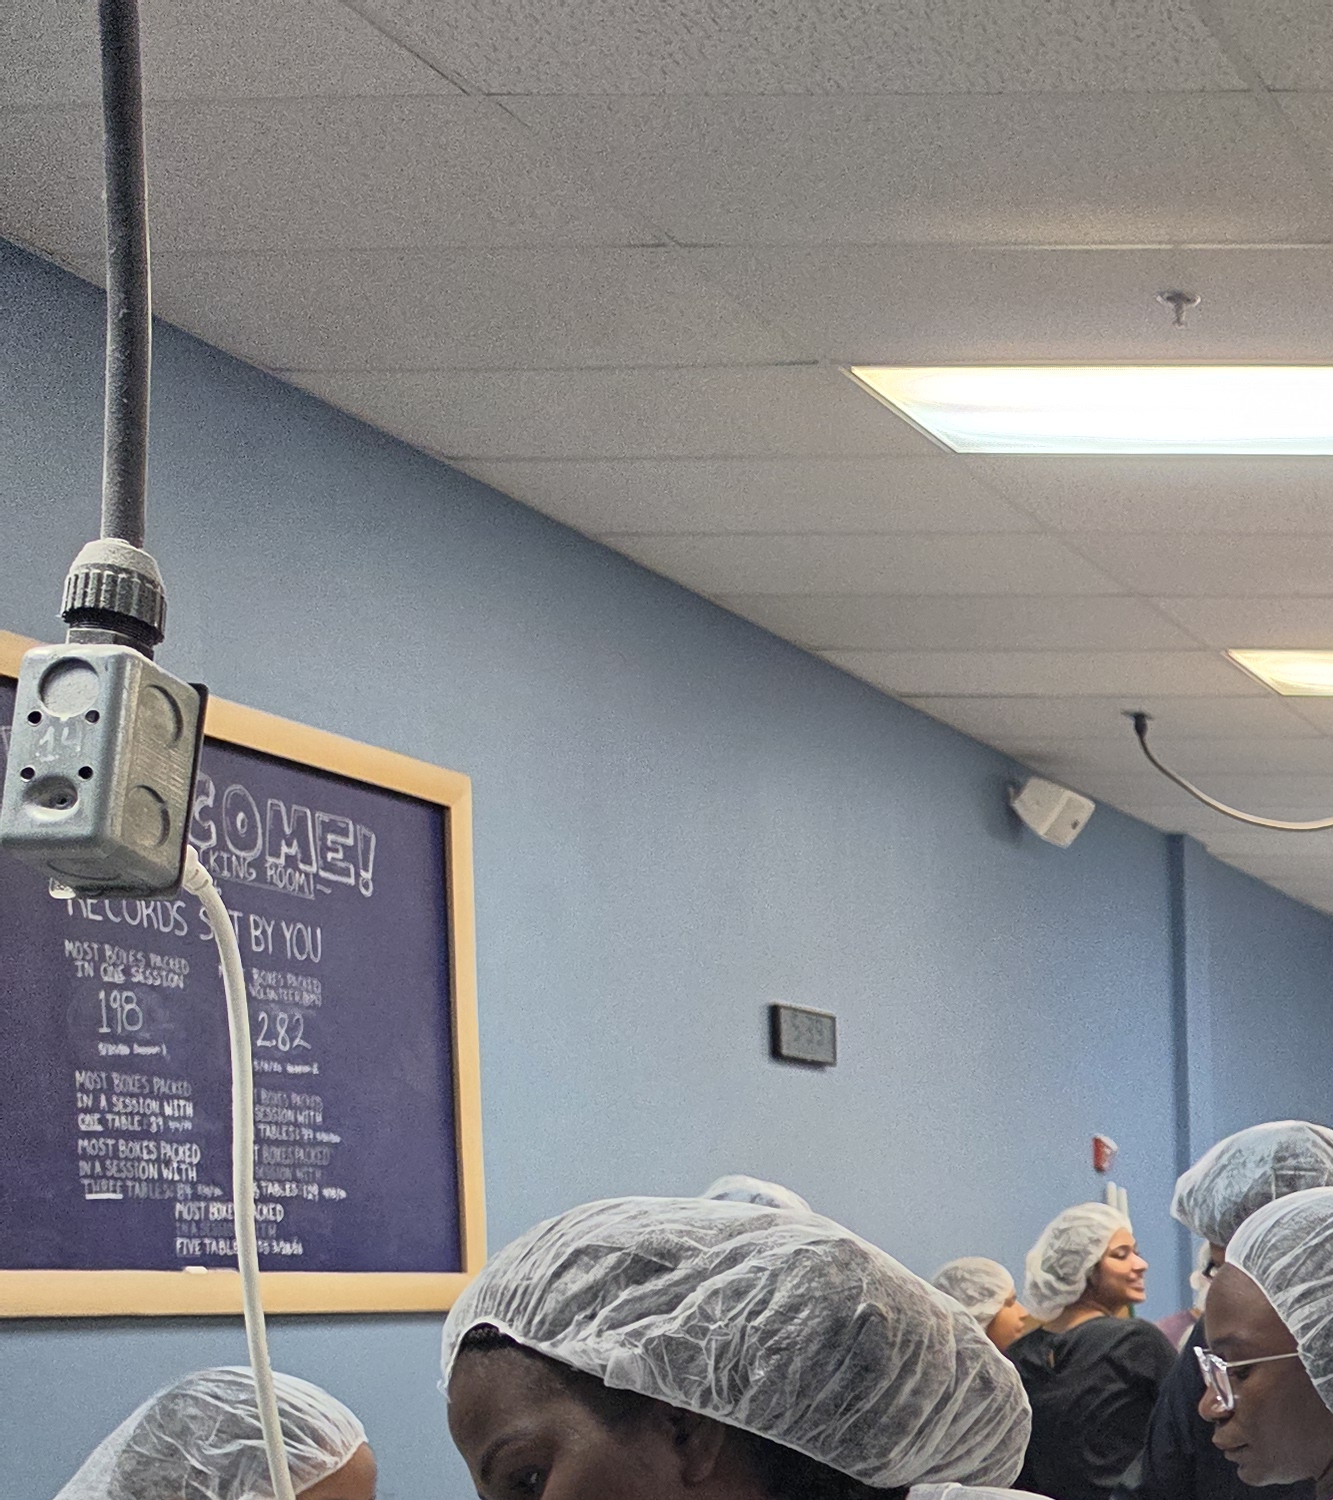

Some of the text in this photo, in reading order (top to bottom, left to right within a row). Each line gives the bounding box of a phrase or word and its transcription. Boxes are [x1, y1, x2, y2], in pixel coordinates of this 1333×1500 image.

[189, 773, 376, 898] COME!
[199, 906, 243, 945] ST
[250, 914, 275, 955] BY
[281, 919, 322, 963] YOU
[64, 939, 99, 961] MOST
[75, 961, 94, 977] IN
[130, 965, 185, 989] SESSION
[98, 989, 143, 1034] 198
[257, 1011, 312, 1051] 282
[75, 1070, 108, 1090] MOST
[76, 1092, 194, 1118] IN A SESSION WITH
[77, 1138, 201, 1165] MOST BOXES PACKED
[79, 1160, 197, 1182] IN A SESSION WITH
[175, 1202, 284, 1222] MOST BOXE CKED
[176, 1238, 238, 1257] FIVE TABLE
